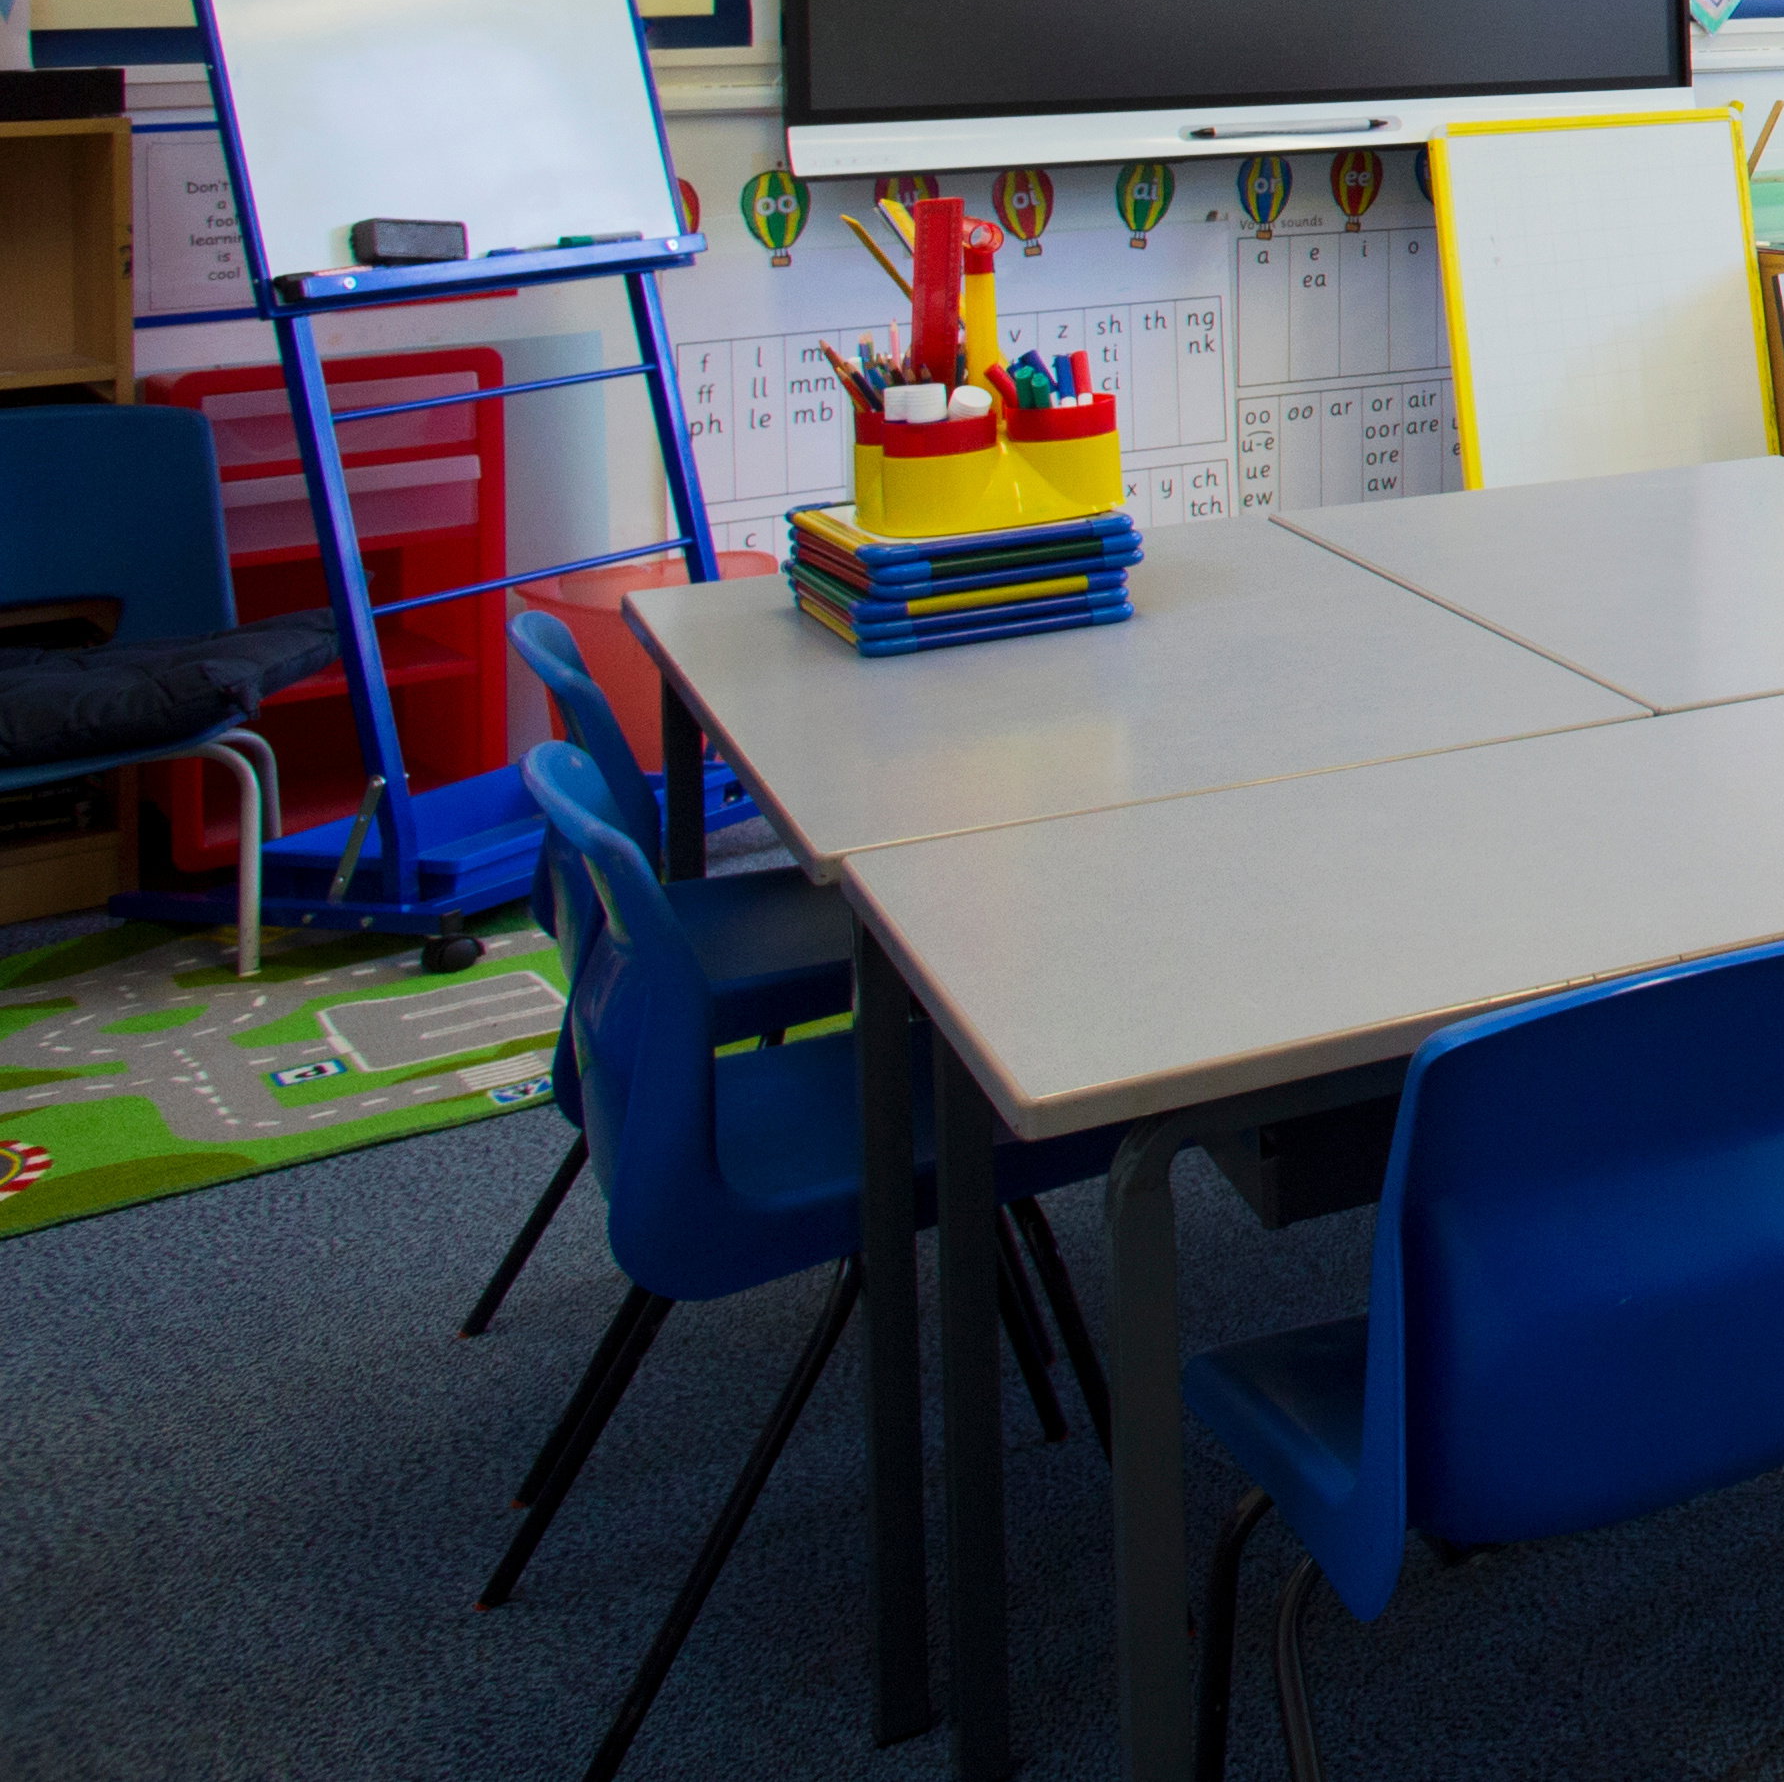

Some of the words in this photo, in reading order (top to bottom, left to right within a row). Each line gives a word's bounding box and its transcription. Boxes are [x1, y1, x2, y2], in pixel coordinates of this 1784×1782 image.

[187, 180, 229, 195] Don't
[1253, 175, 1281, 195] or
[1346, 169, 1371, 187] ee
[1011, 185, 1040, 209] oi
[1133, 179, 1159, 202] ai
[217, 201, 227, 209] a
[757, 194, 798, 218] oo
[1281, 215, 1323, 228] sounds
[217, 253, 231, 262] is
[1258, 250, 1269, 264] a
[1309, 247, 1320, 261] e
[1360, 239, 1367, 258] i
[1408, 241, 1419, 254] o
[208, 267, 240, 280] cool
[1303, 273, 1326, 288] ea
[701, 352, 710, 373] f
[1010, 329, 1021, 343] v
[1058, 324, 1068, 339] z
[1097, 314, 1122, 335] sh
[1144, 310, 1167, 330] th
[1187, 310, 1215, 331] ng
[698, 385, 713, 405] ff
[752, 376, 768, 398] ll
[790, 375, 836, 394] mm
[1103, 343, 1119, 362] ti
[1189, 334, 1216, 354] nk
[690, 415, 723, 438] ph
[750, 407, 771, 429] le
[795, 402, 833, 424] mb
[1102, 372, 1120, 391] ci
[1246, 410, 1271, 425] oo
[1288, 405, 1313, 421] oo
[1330, 400, 1353, 416] ar
[1372, 396, 1393, 413] or
[1408, 389, 1436, 409] air
[1242, 436, 1274, 452] u-e
[1365, 422, 1400, 439] oor
[1407, 417, 1439, 435] are
[1246, 463, 1270, 480] ue
[1366, 448, 1399, 465] ore
[1243, 491, 1273, 507] ew
[1368, 476, 1397, 492] aw
[745, 531, 756, 548] c
[1126, 482, 1137, 497] x
[1161, 477, 1173, 498] y
[1193, 468, 1218, 489] ch
[1190, 495, 1223, 517] tch
